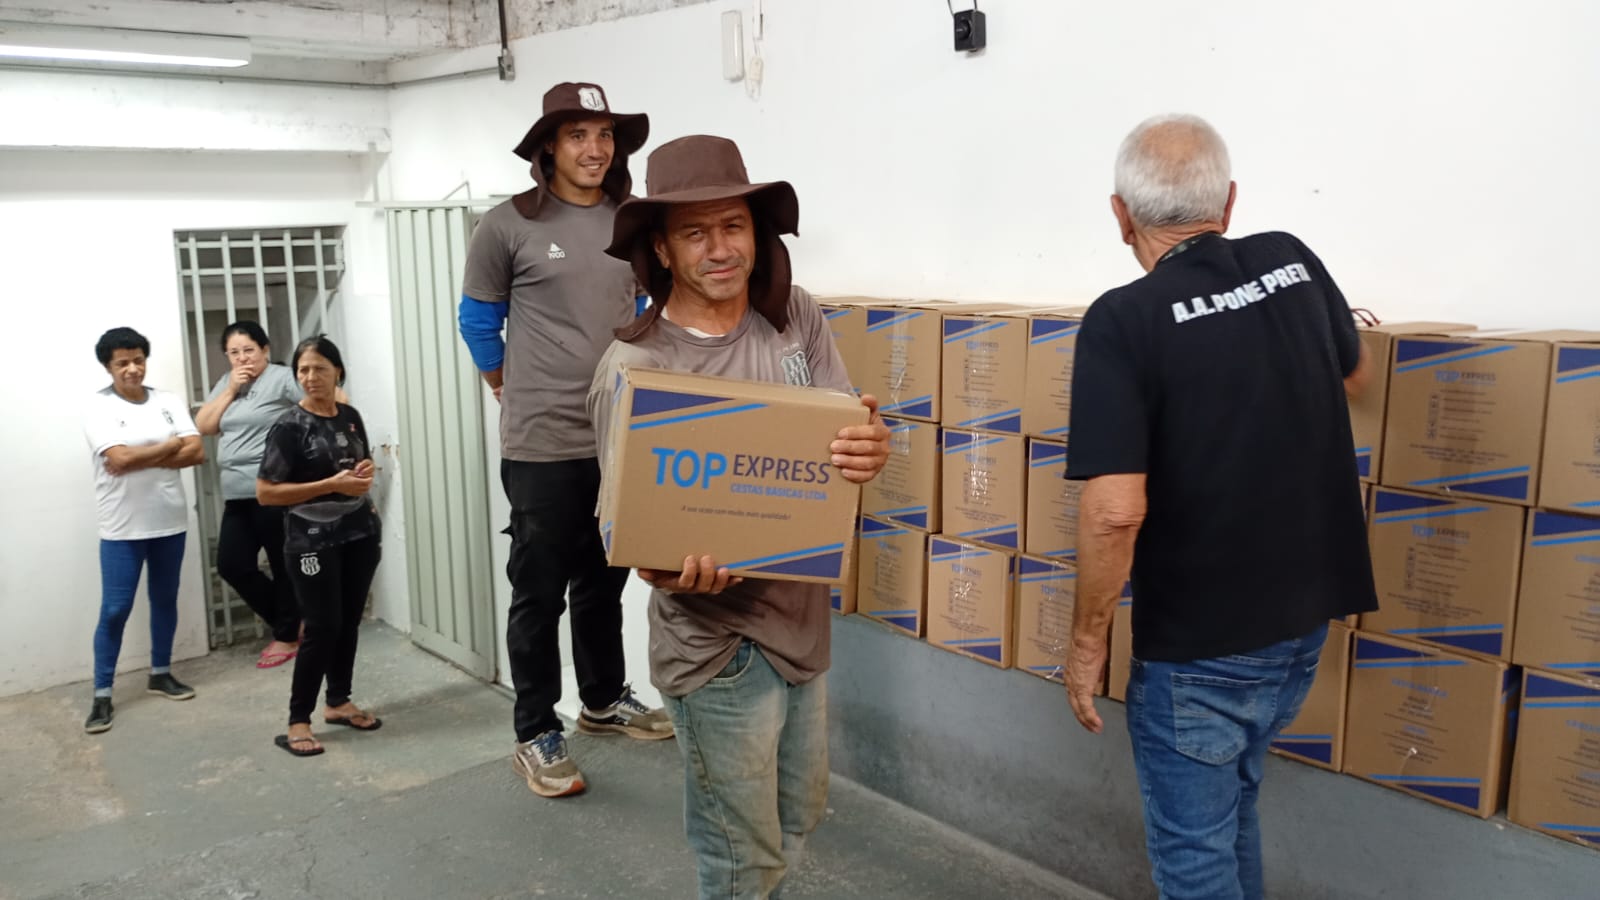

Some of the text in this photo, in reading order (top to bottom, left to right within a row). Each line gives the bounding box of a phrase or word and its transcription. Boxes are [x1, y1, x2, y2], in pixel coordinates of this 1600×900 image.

[548, 251, 565, 260] 1900
[651, 447, 728, 490] TOP
[732, 454, 831, 485] EXPRESS
